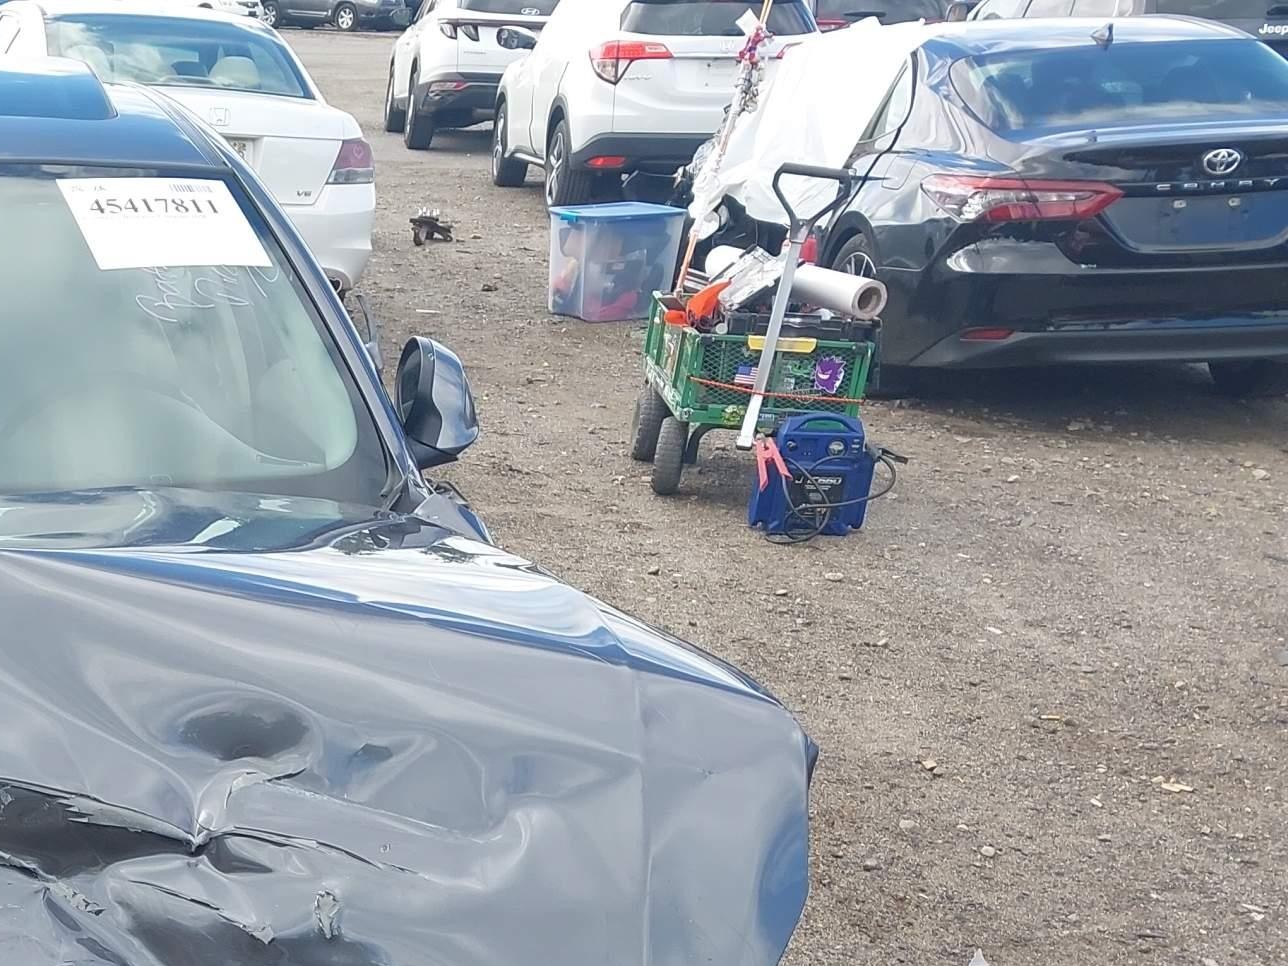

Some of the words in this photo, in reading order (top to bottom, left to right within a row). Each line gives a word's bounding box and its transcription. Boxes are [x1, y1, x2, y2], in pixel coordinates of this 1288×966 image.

[1258, 23, 1288, 36] Jeep
[1156, 177, 1280, 191] CAMRY
[89, 197, 219, 214] 45417811
